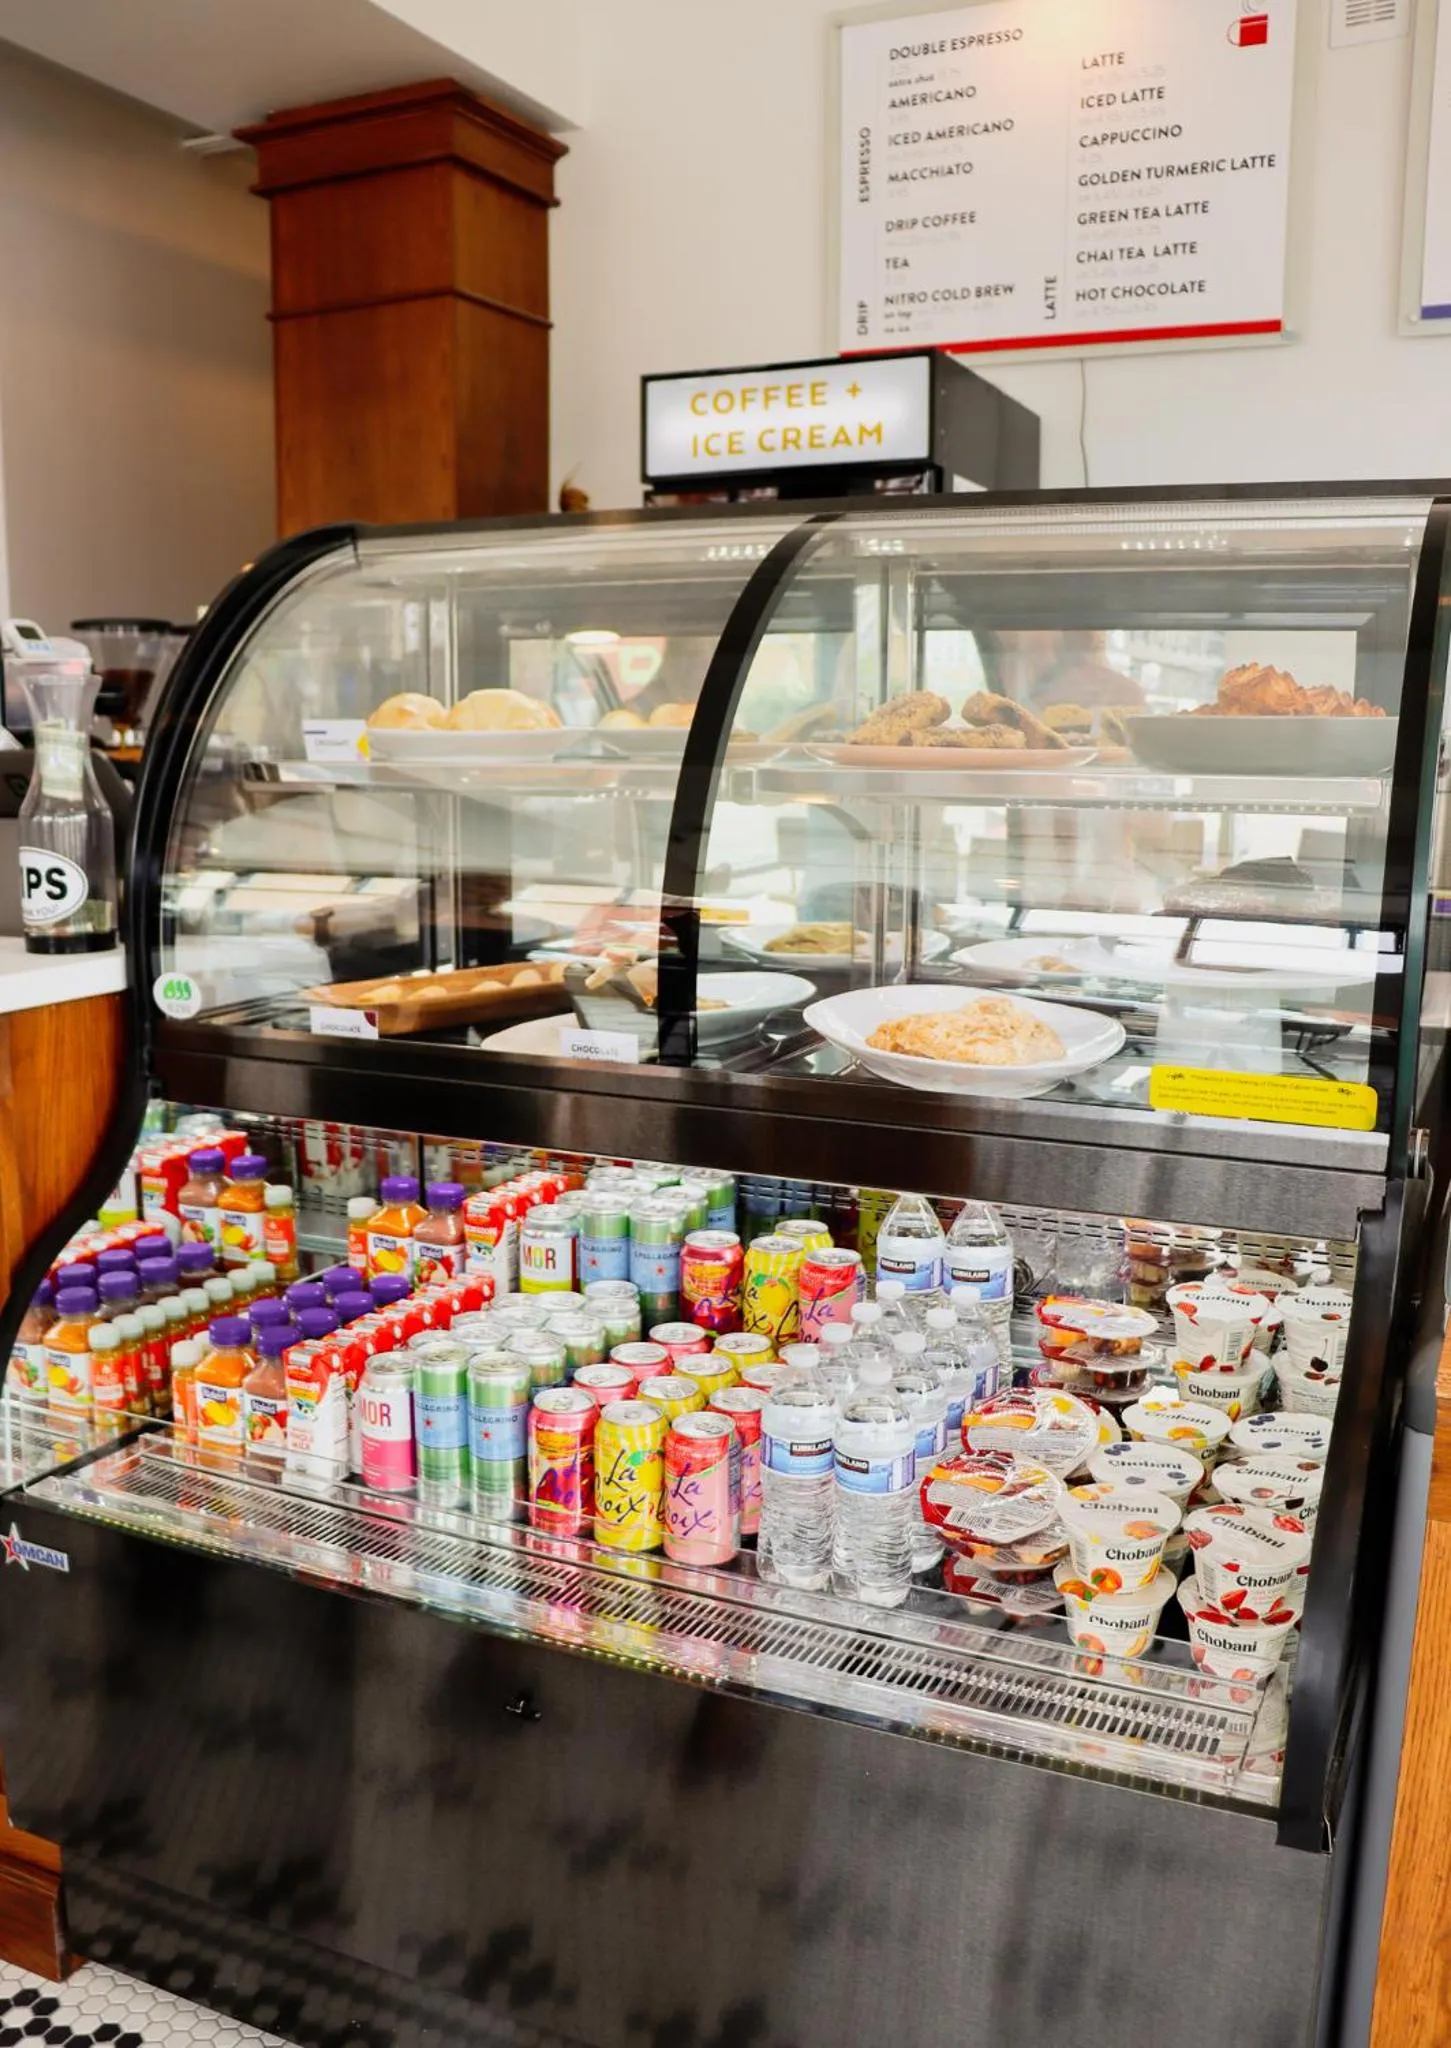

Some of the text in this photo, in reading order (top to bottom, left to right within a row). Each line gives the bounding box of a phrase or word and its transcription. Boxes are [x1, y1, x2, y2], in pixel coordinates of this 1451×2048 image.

[889, 28, 1024, 61] DOUBLE ESPRESSO
[1081, 52, 1125, 70] LATTE
[888, 85, 978, 109] AMERICANO
[1080, 86, 1166, 109] ICED LATTE
[888, 130, 922, 147] ICED
[926, 118, 1016, 142] AMERICANO
[1079, 124, 1183, 148] CAPPUCCINO
[858, 126, 872, 203] ESPRESSO
[887, 160, 974, 184] MACCHIATO
[1077, 153, 1277, 188] GOLDEN TURMERIC LATTE
[885, 210, 977, 233] DRIP COFFEE
[1076, 199, 1210, 226] GREEN TEA LATTE
[884, 256, 910, 270] TEA
[1076, 240, 1198, 264] CHAI TEA LATTE
[884, 283, 1016, 306] NITRO COLD BREW
[1044, 275, 1058, 320] LATTE
[1075, 279, 1207, 302] HOT CHOCOLATE
[856, 299, 869, 336] DRIP
[690, 381, 862, 416] COFFEE +
[691, 420, 885, 459] ICE CREAM
[1188, 1383, 1241, 1400] Chobani
[603, 1449, 637, 1492] La
[670, 1463, 703, 1506] La
[1211, 1515, 1287, 1549] Chobani
[1196, 1628, 1258, 1653] Chobani
